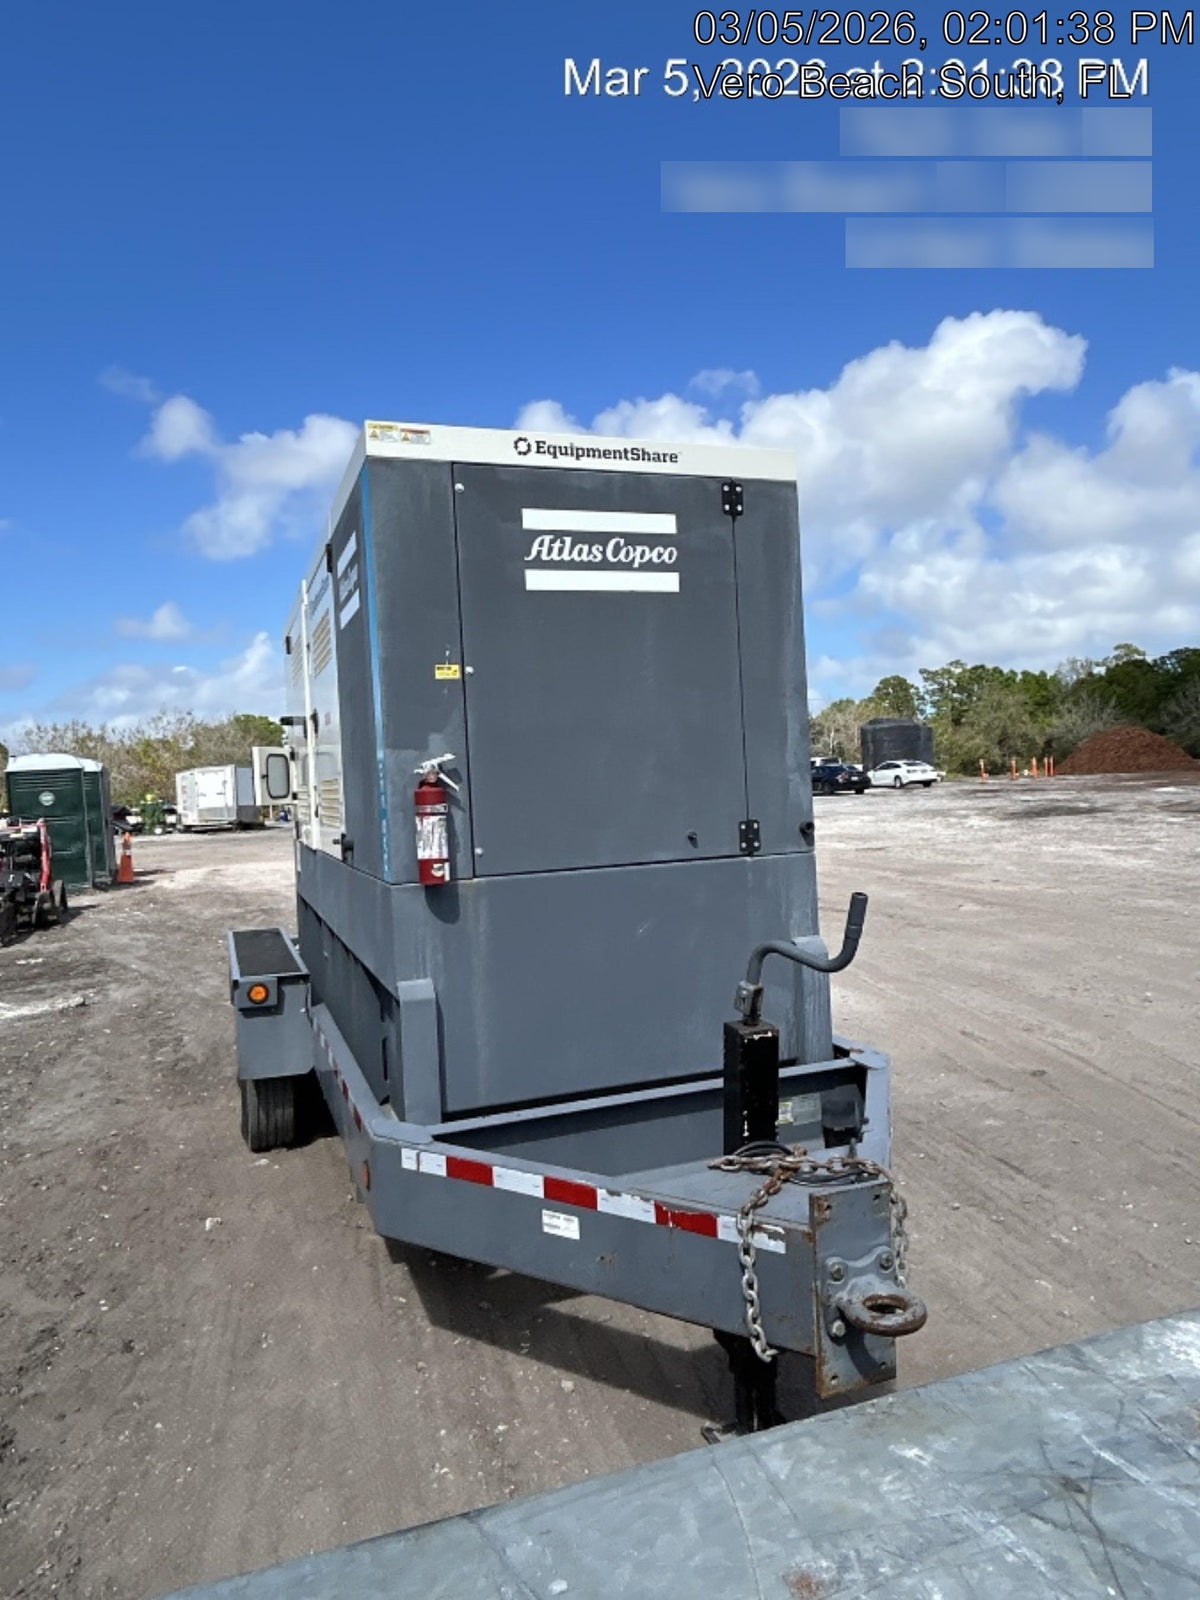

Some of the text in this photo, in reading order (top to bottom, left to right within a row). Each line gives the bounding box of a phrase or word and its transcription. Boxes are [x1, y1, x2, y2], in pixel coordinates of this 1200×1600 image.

[534, 439, 679, 464] EquipmentShare
[524, 535, 678, 569] Atlas Copco
